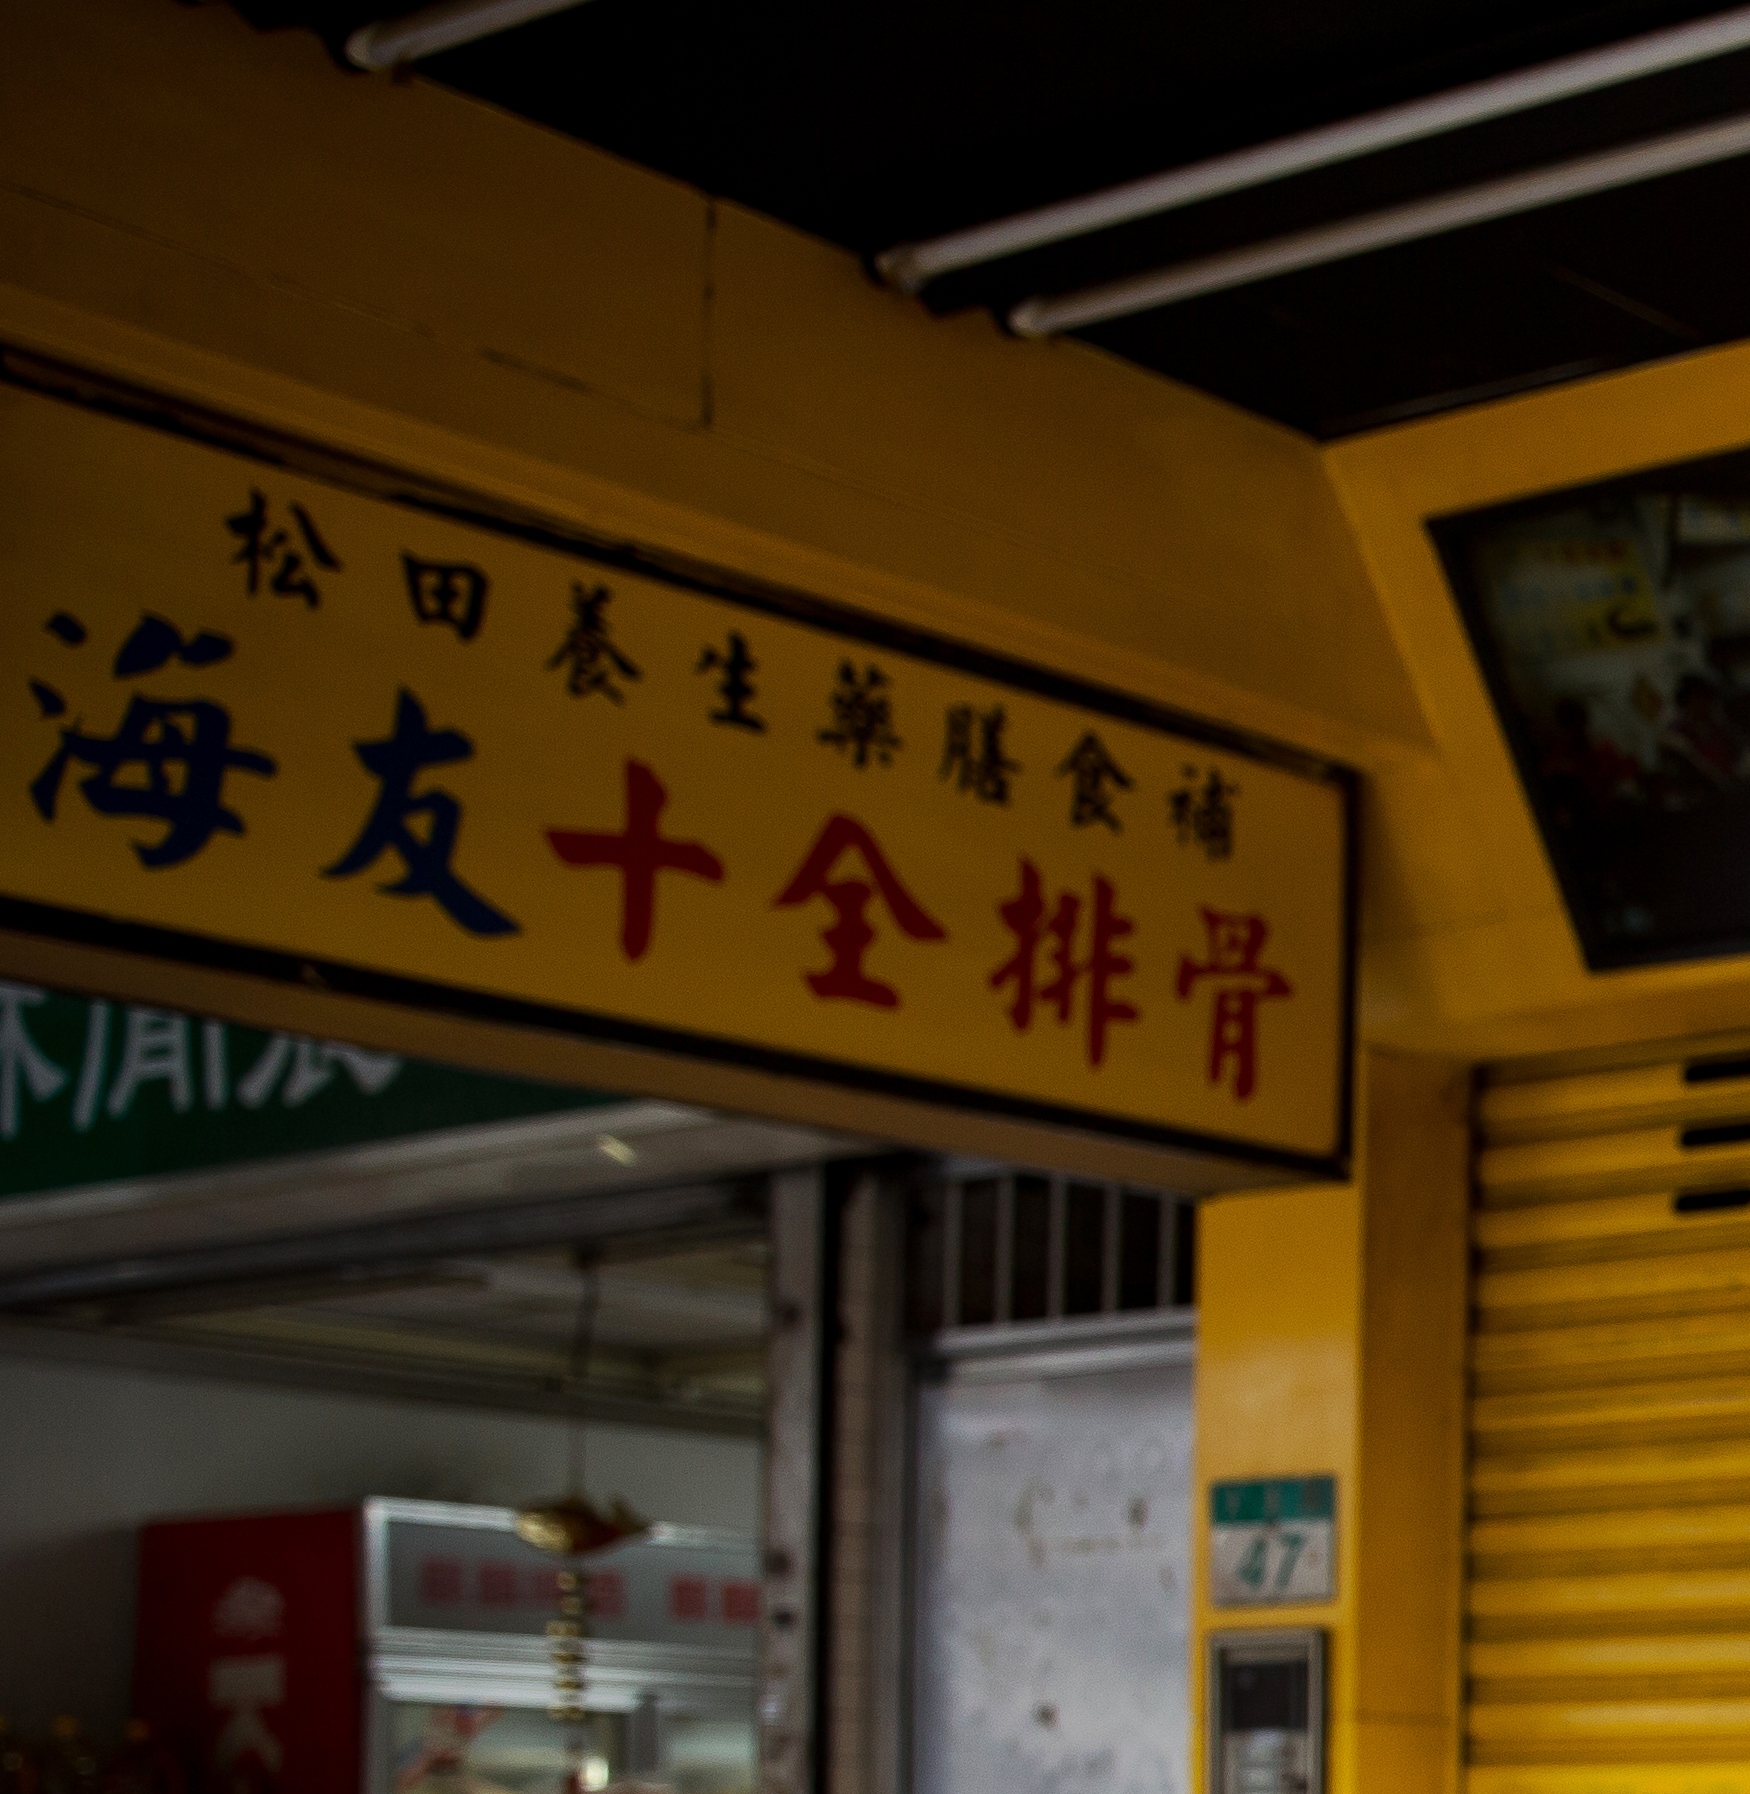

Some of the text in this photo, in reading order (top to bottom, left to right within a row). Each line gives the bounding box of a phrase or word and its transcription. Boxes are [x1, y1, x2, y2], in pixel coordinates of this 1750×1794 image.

[28, 611, 1293, 1100] 海友十全排骨
[1239, 1533, 1304, 1590] 47
